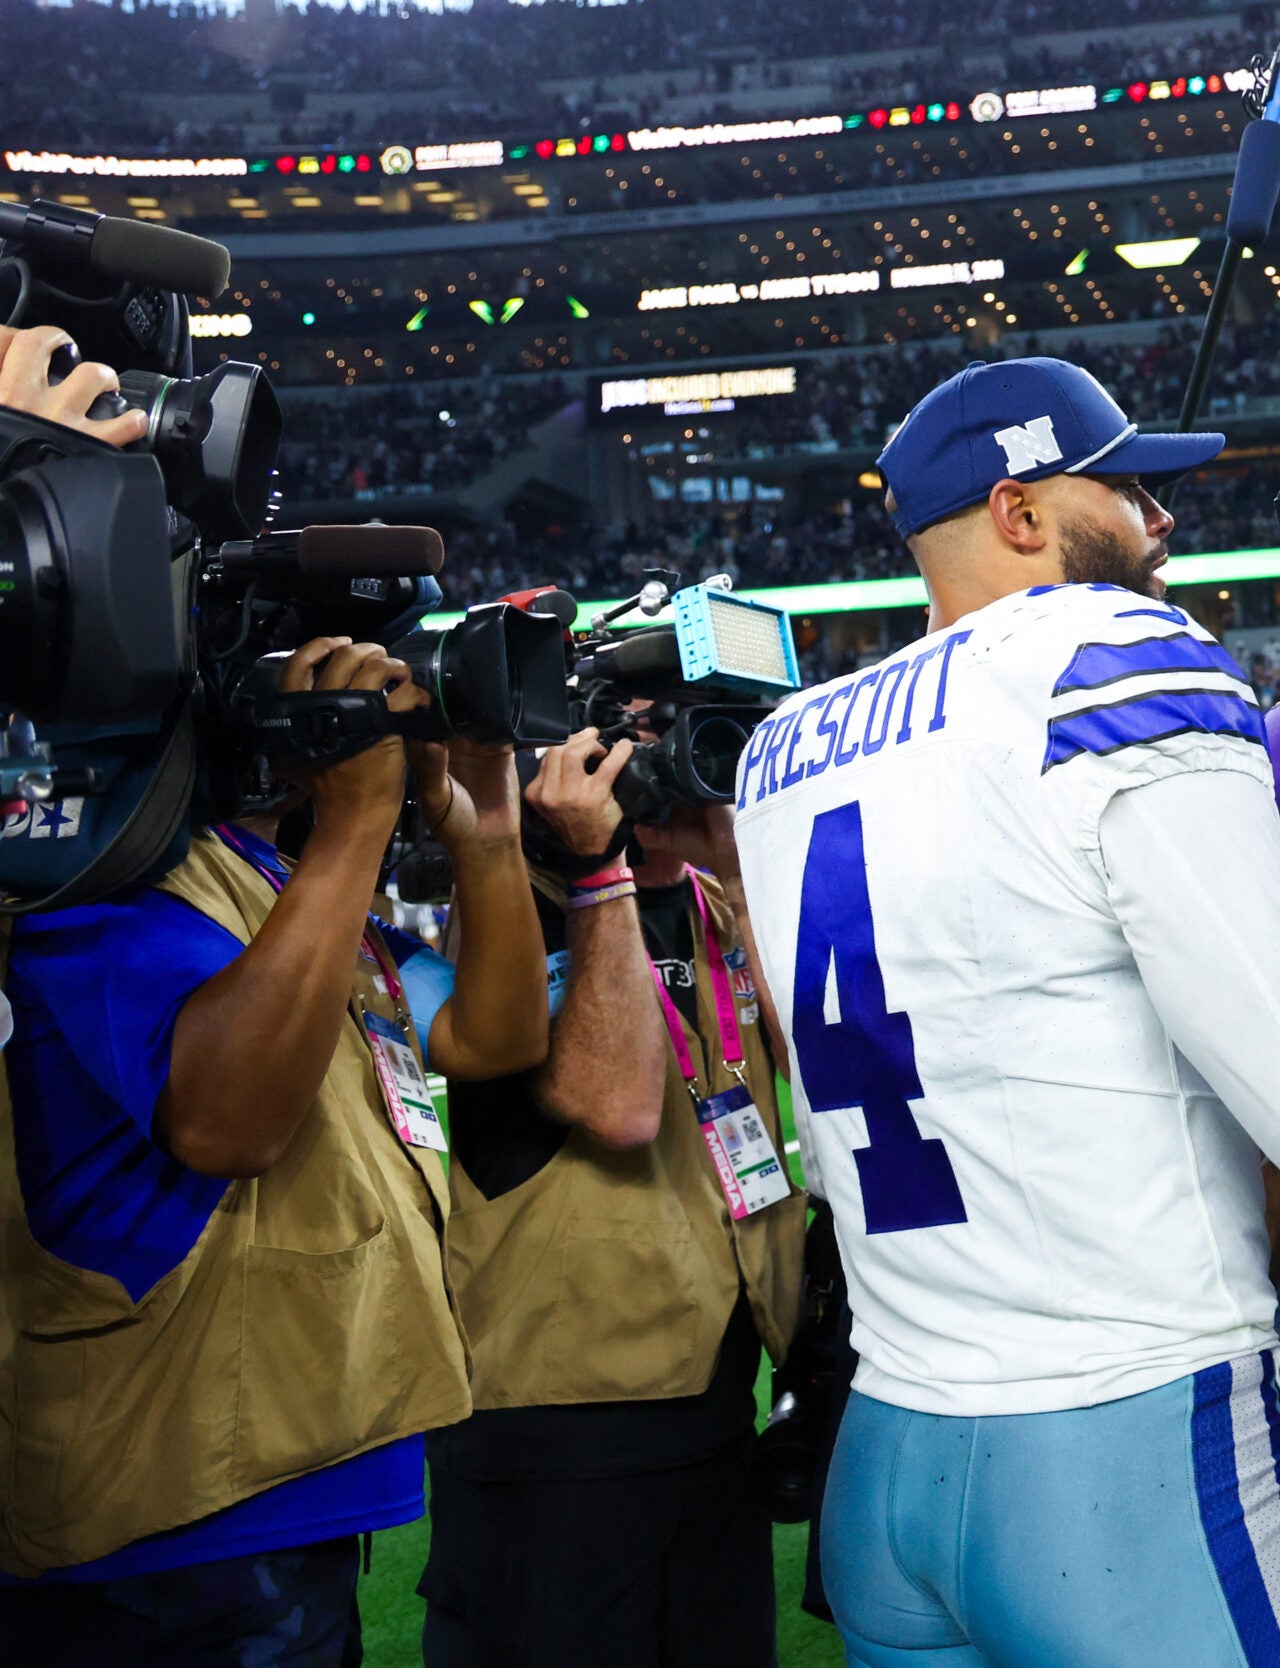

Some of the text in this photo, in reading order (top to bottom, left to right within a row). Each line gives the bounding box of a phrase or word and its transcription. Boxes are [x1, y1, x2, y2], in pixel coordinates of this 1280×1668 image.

[994, 415, 1063, 476] N
[736, 629, 974, 812] PRESCOTT
[792, 800, 968, 1235] 4
[372, 1040, 407, 1130] MEDIA
[705, 1130, 741, 1212] MEDIA
